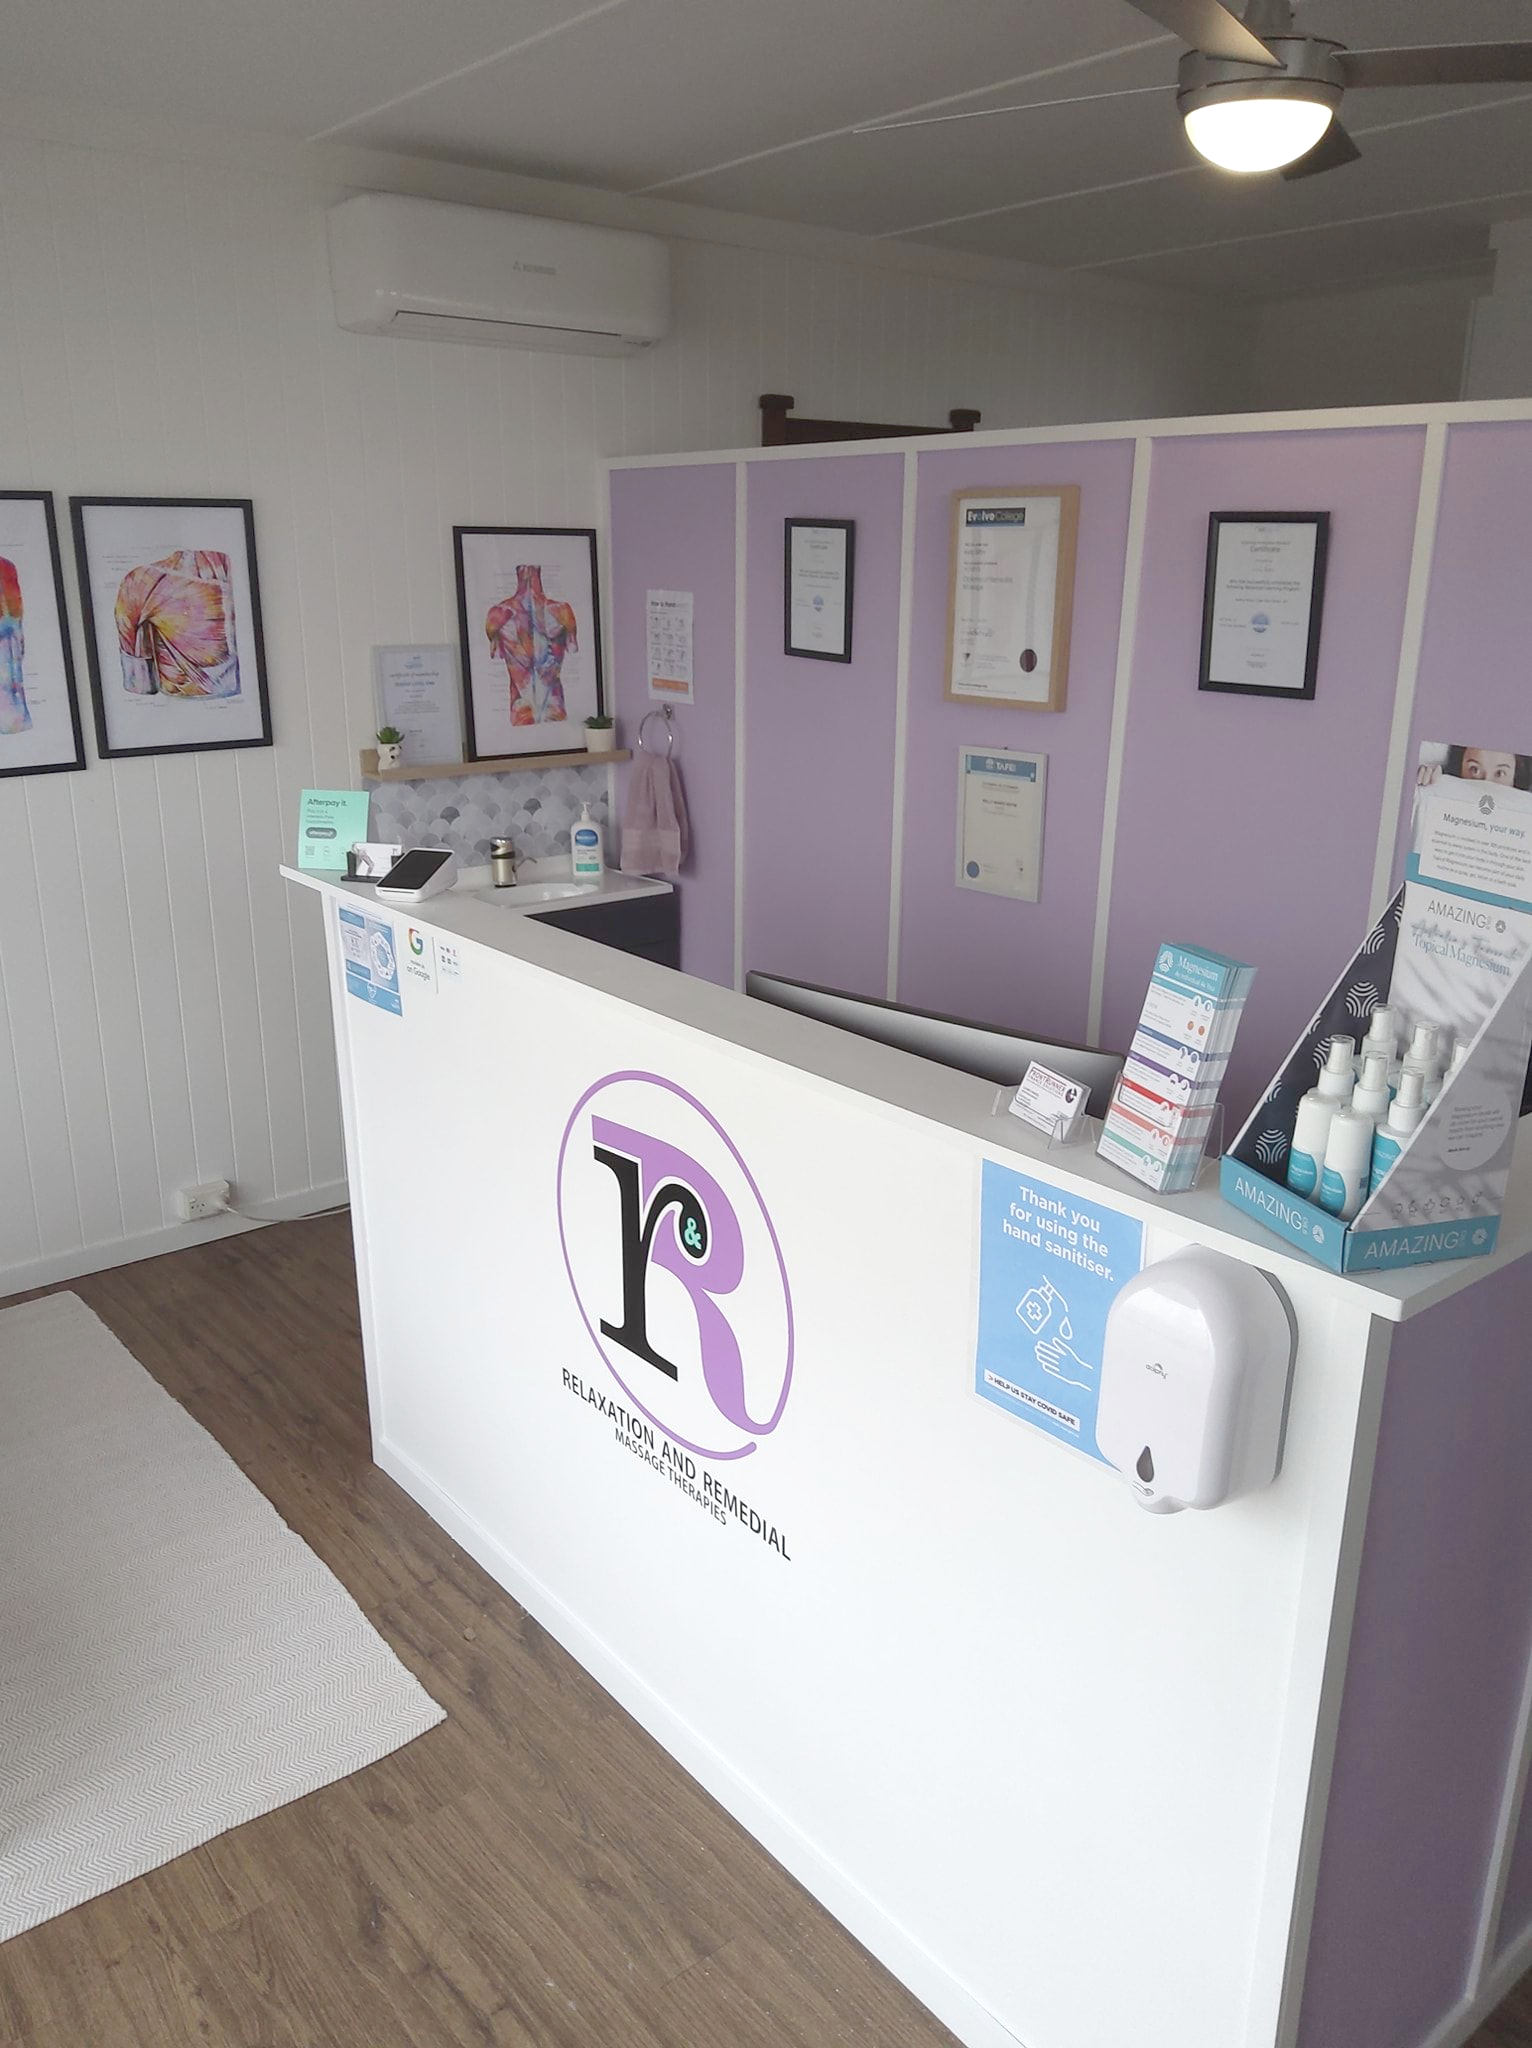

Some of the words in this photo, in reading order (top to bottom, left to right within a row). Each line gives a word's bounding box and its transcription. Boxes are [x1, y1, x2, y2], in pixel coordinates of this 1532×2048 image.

[307, 798, 340, 807] Afterpay
[1443, 813, 1488, 831] Magnesium,
[1489, 824, 1507, 834] your
[1427, 900, 1486, 929] AMAZING
[1412, 933, 1449, 956] Topical
[1449, 944, 1511, 977] Magnesium
[1019, 1185, 1067, 1219] Thank
[1071, 1209, 1100, 1233] you
[1234, 1177, 1302, 1230] AMAZING
[1002, 1218, 1041, 1248] hand
[1045, 1240, 1114, 1281] sanitiser.
[1009, 1202, 1032, 1223] for
[1036, 1215, 1078, 1246] using
[1082, 1233, 1109, 1257] the
[1363, 1230, 1460, 1260] AMAZING
[994, 1377, 1011, 1390] HELP
[1011, 1386, 1019, 1396] US
[1020, 1392, 1037, 1404] STAY
[1037, 1401, 1058, 1415] COVID
[1058, 1412, 1076, 1426] SAFE
[562, 1367, 654, 1450] RELAXATION
[662, 1440, 696, 1480] AND
[703, 1470, 791, 1562] REMEDIAL
[615, 1427, 666, 1476] MASSAGE
[667, 1465, 727, 1525] THERAPIES
